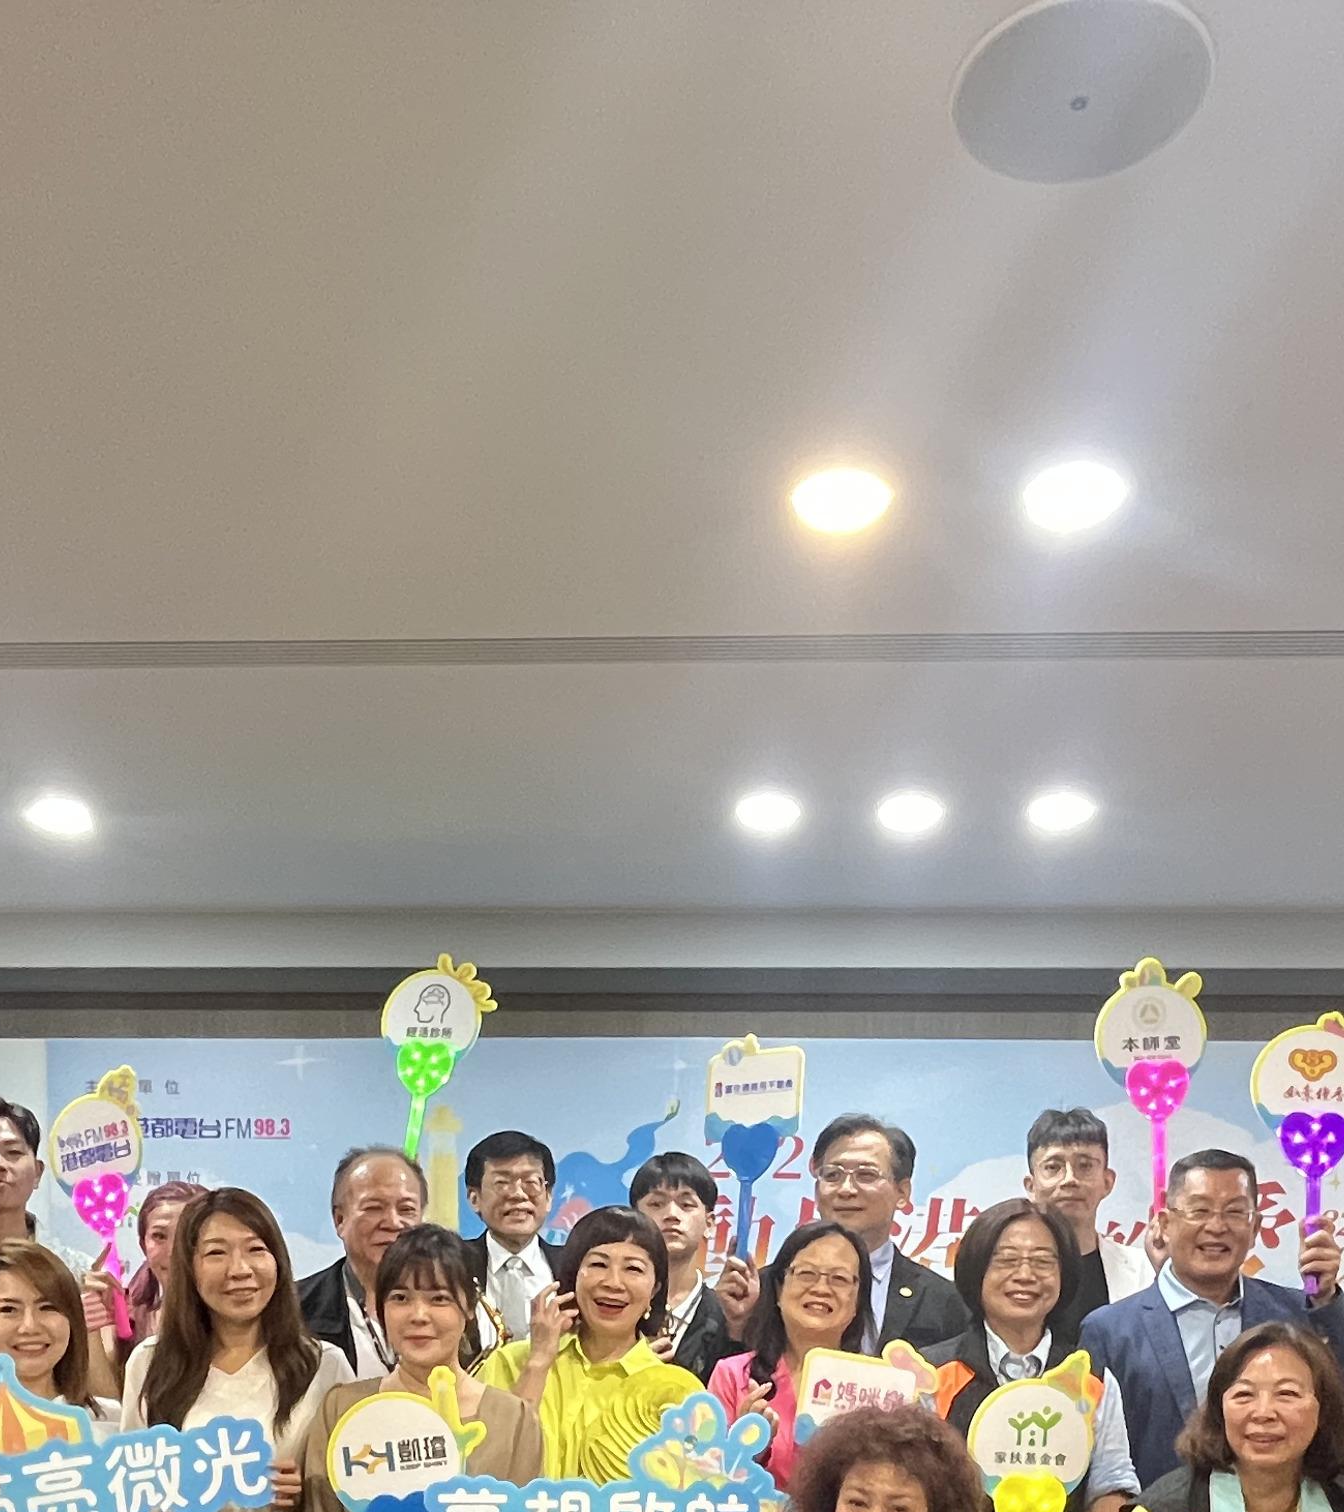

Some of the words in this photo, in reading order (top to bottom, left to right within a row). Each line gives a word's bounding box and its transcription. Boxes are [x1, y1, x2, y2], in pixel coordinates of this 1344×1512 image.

[225, 1118, 252, 1140] FM
[254, 1117, 291, 1137] 98.3
[994, 1451, 1067, 1466] 家扶基金會
